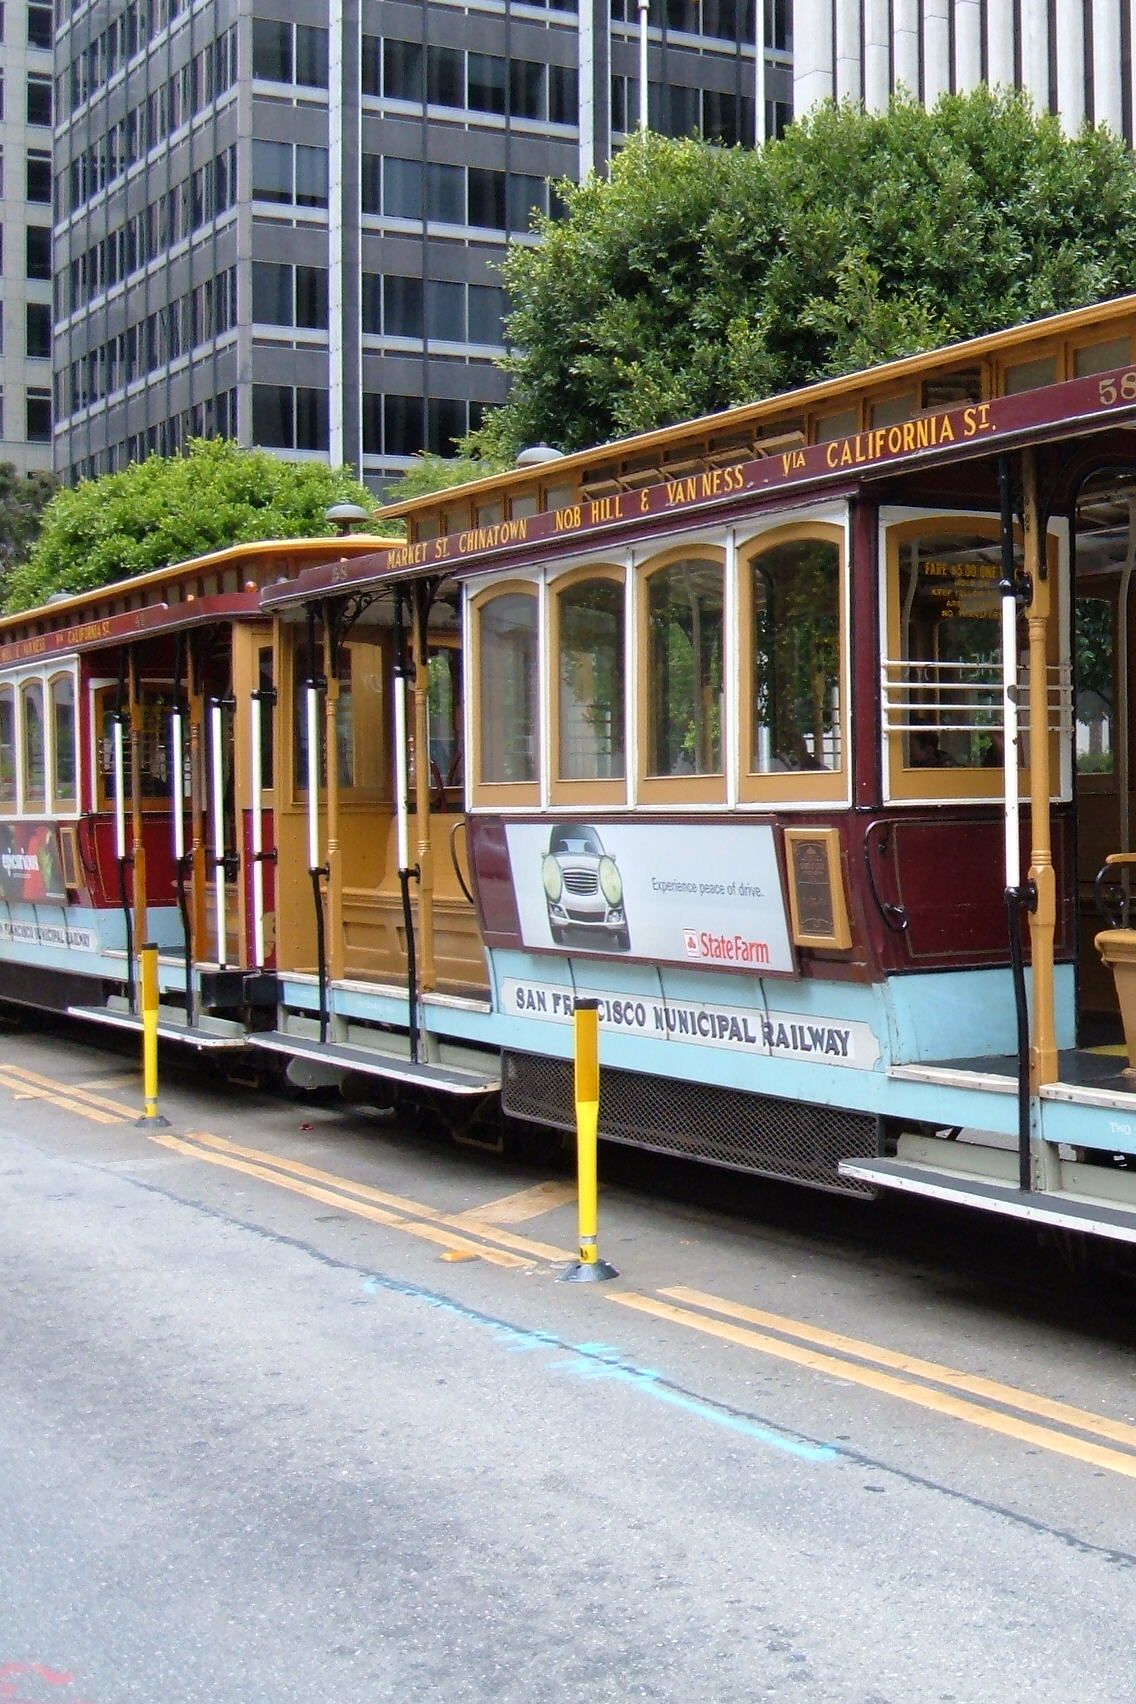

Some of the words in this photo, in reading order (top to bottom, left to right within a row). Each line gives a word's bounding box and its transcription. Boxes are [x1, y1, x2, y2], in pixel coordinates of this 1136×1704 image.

[387, 542, 427, 570] MARKET
[458, 518, 528, 554] CHINATOWN
[555, 506, 581, 532] NOB
[591, 497, 623, 524] HILL
[667, 477, 697, 505] VAN
[702, 464, 745, 497] NESS
[782, 451, 806, 478] VIA
[826, 415, 955, 468] CALIFORNIA
[651, 877, 698, 894] Experience
[700, 883, 726, 896] peace
[727, 882, 736, 895] of
[516, 987, 547, 1011] SAN
[761, 1018, 850, 1056] RAILWAY
